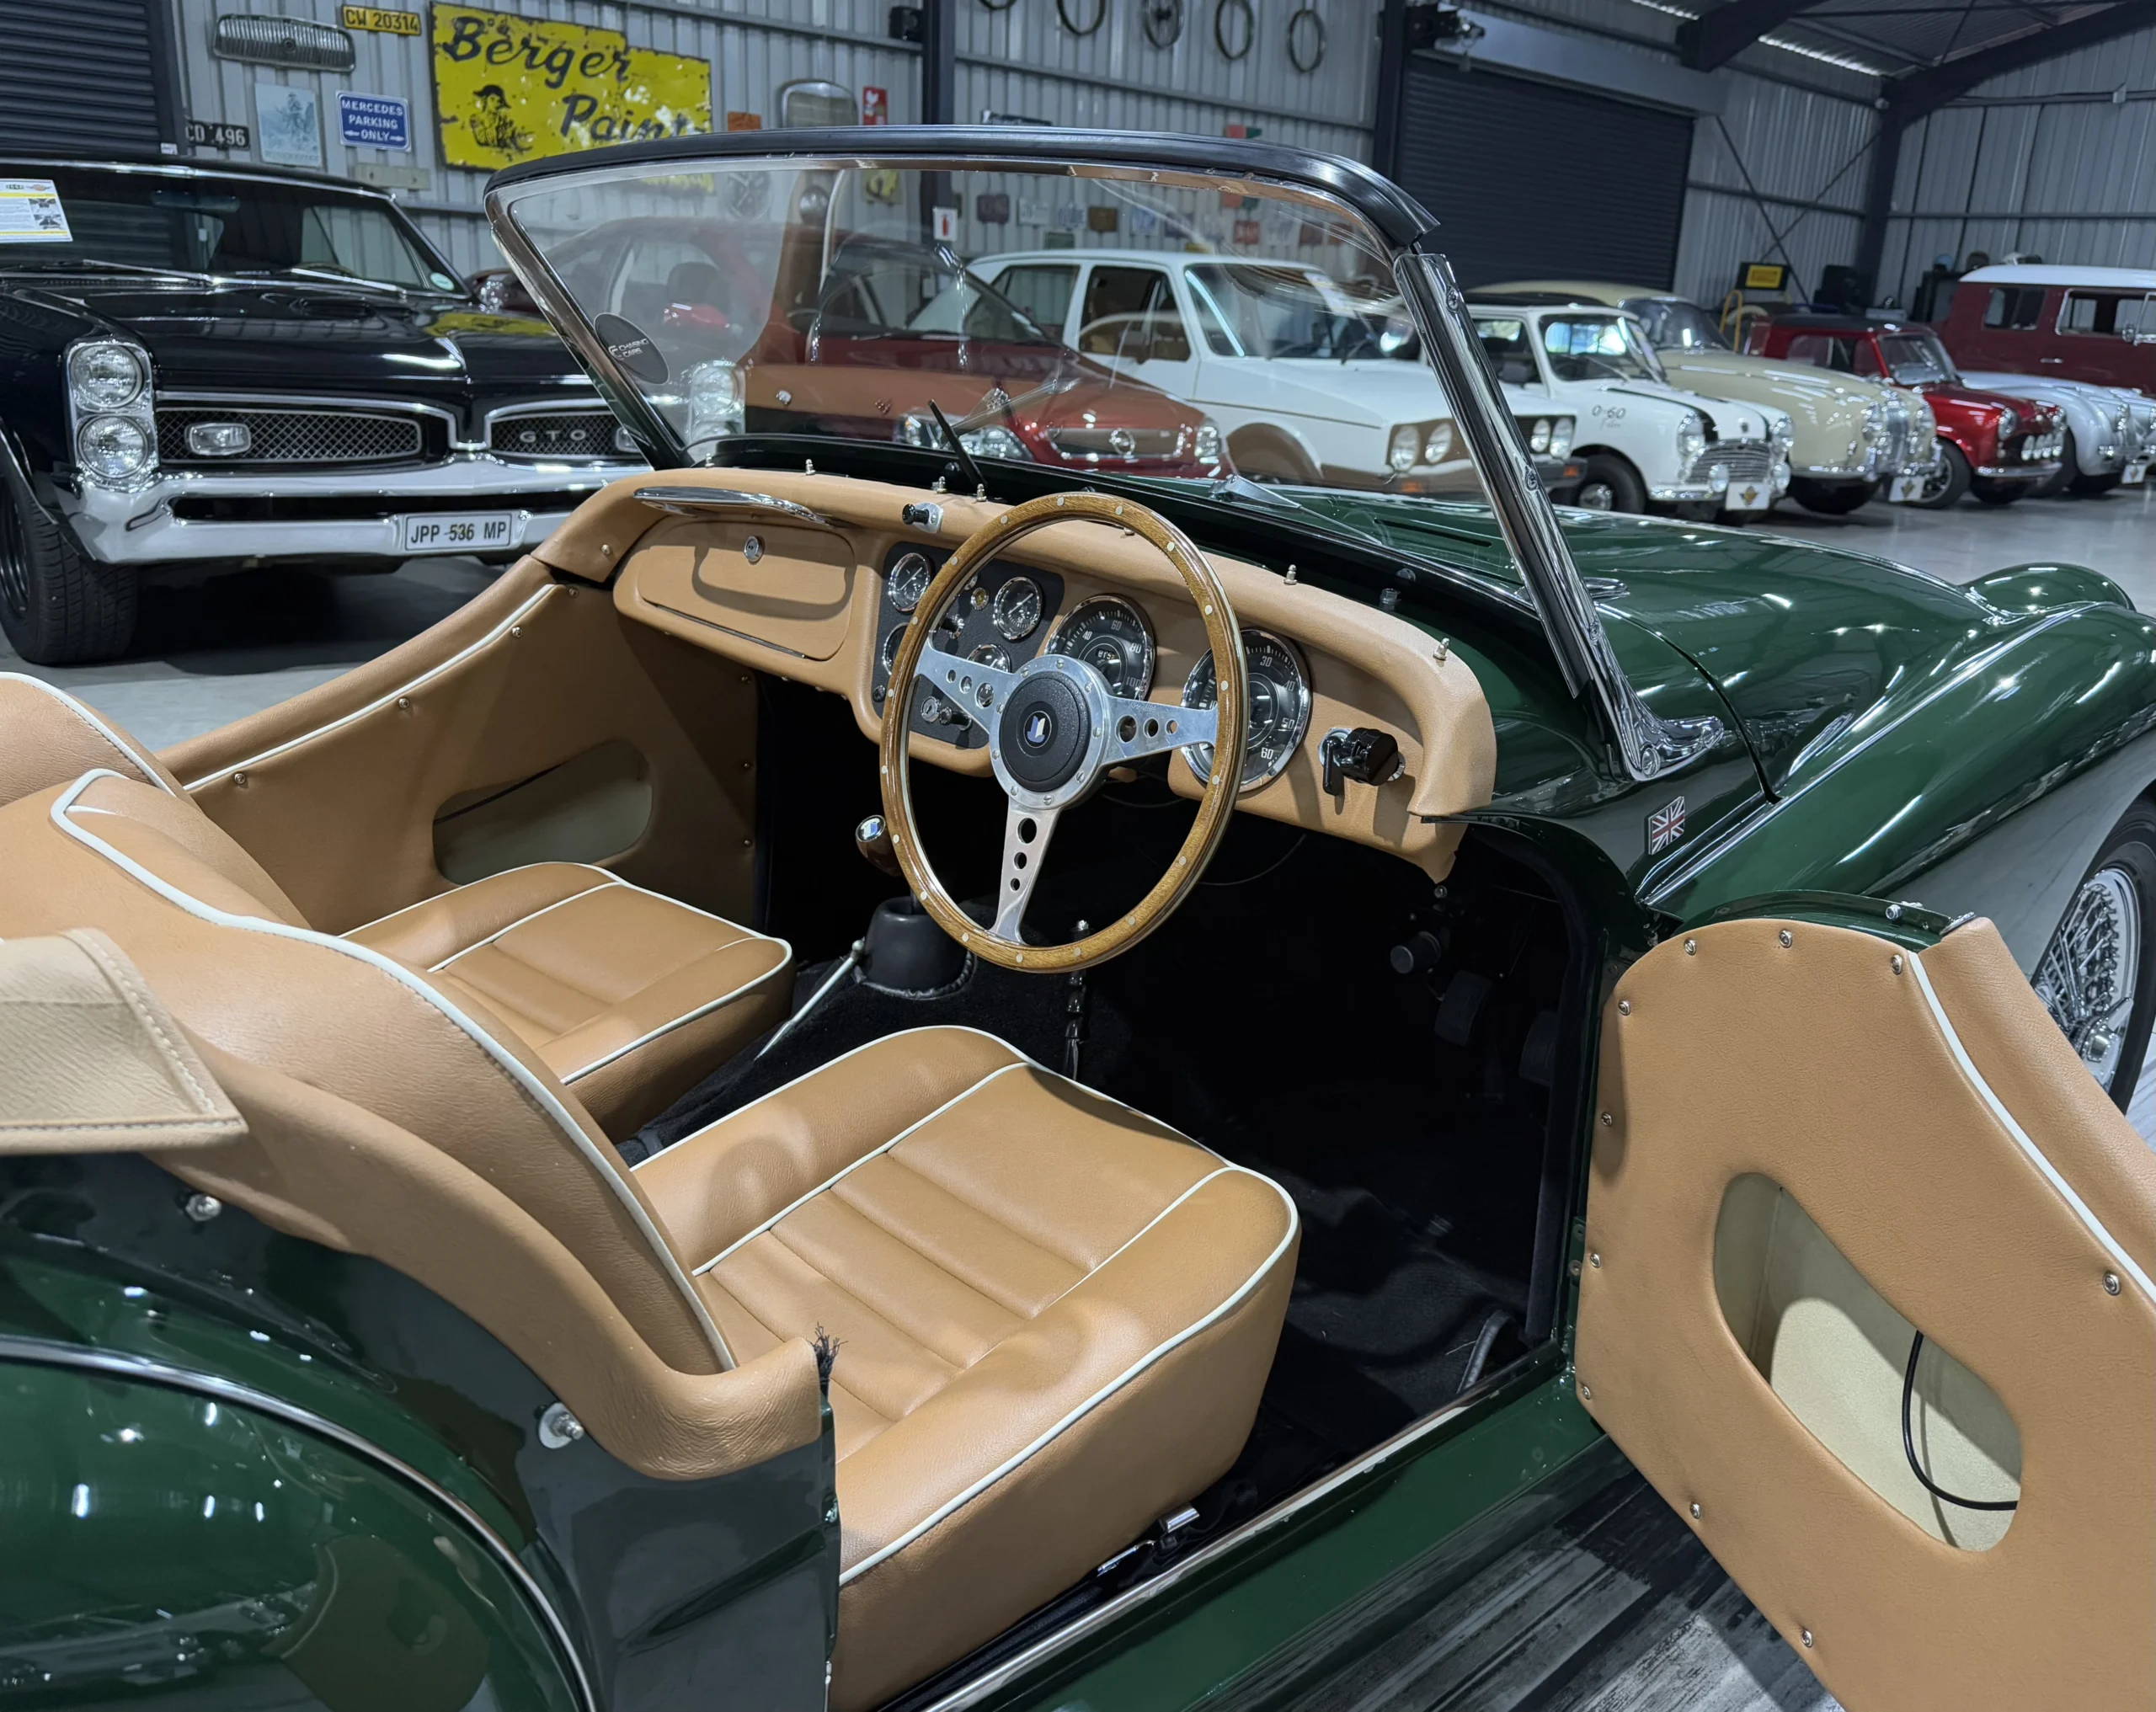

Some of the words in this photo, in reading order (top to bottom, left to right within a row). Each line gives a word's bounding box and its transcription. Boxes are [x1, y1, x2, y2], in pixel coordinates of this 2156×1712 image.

[346, 10, 366, 26] CW
[372, 12, 419, 32] 20314
[442, 16, 631, 89] Berger
[342, 99, 403, 116] MERCEDES
[348, 114, 398, 130] PARKING
[360, 129, 390, 141] ONLY
[618, 338, 649, 350] CHASING
[622, 348, 643, 357] CARS
[520, 429, 586, 443] GTO
[411, 525, 440, 543] JPP
[449, 523, 475, 541] 536
[483, 521, 507, 539] MP
[1111, 620, 1122, 631] 60
[1082, 631, 1093, 641] 40
[1129, 643, 1142, 653] 80
[1260, 656, 1273, 668] 30
[1283, 680, 1296, 691] 40
[1282, 717, 1295, 729] 50
[1261, 746, 1274, 760] 60
